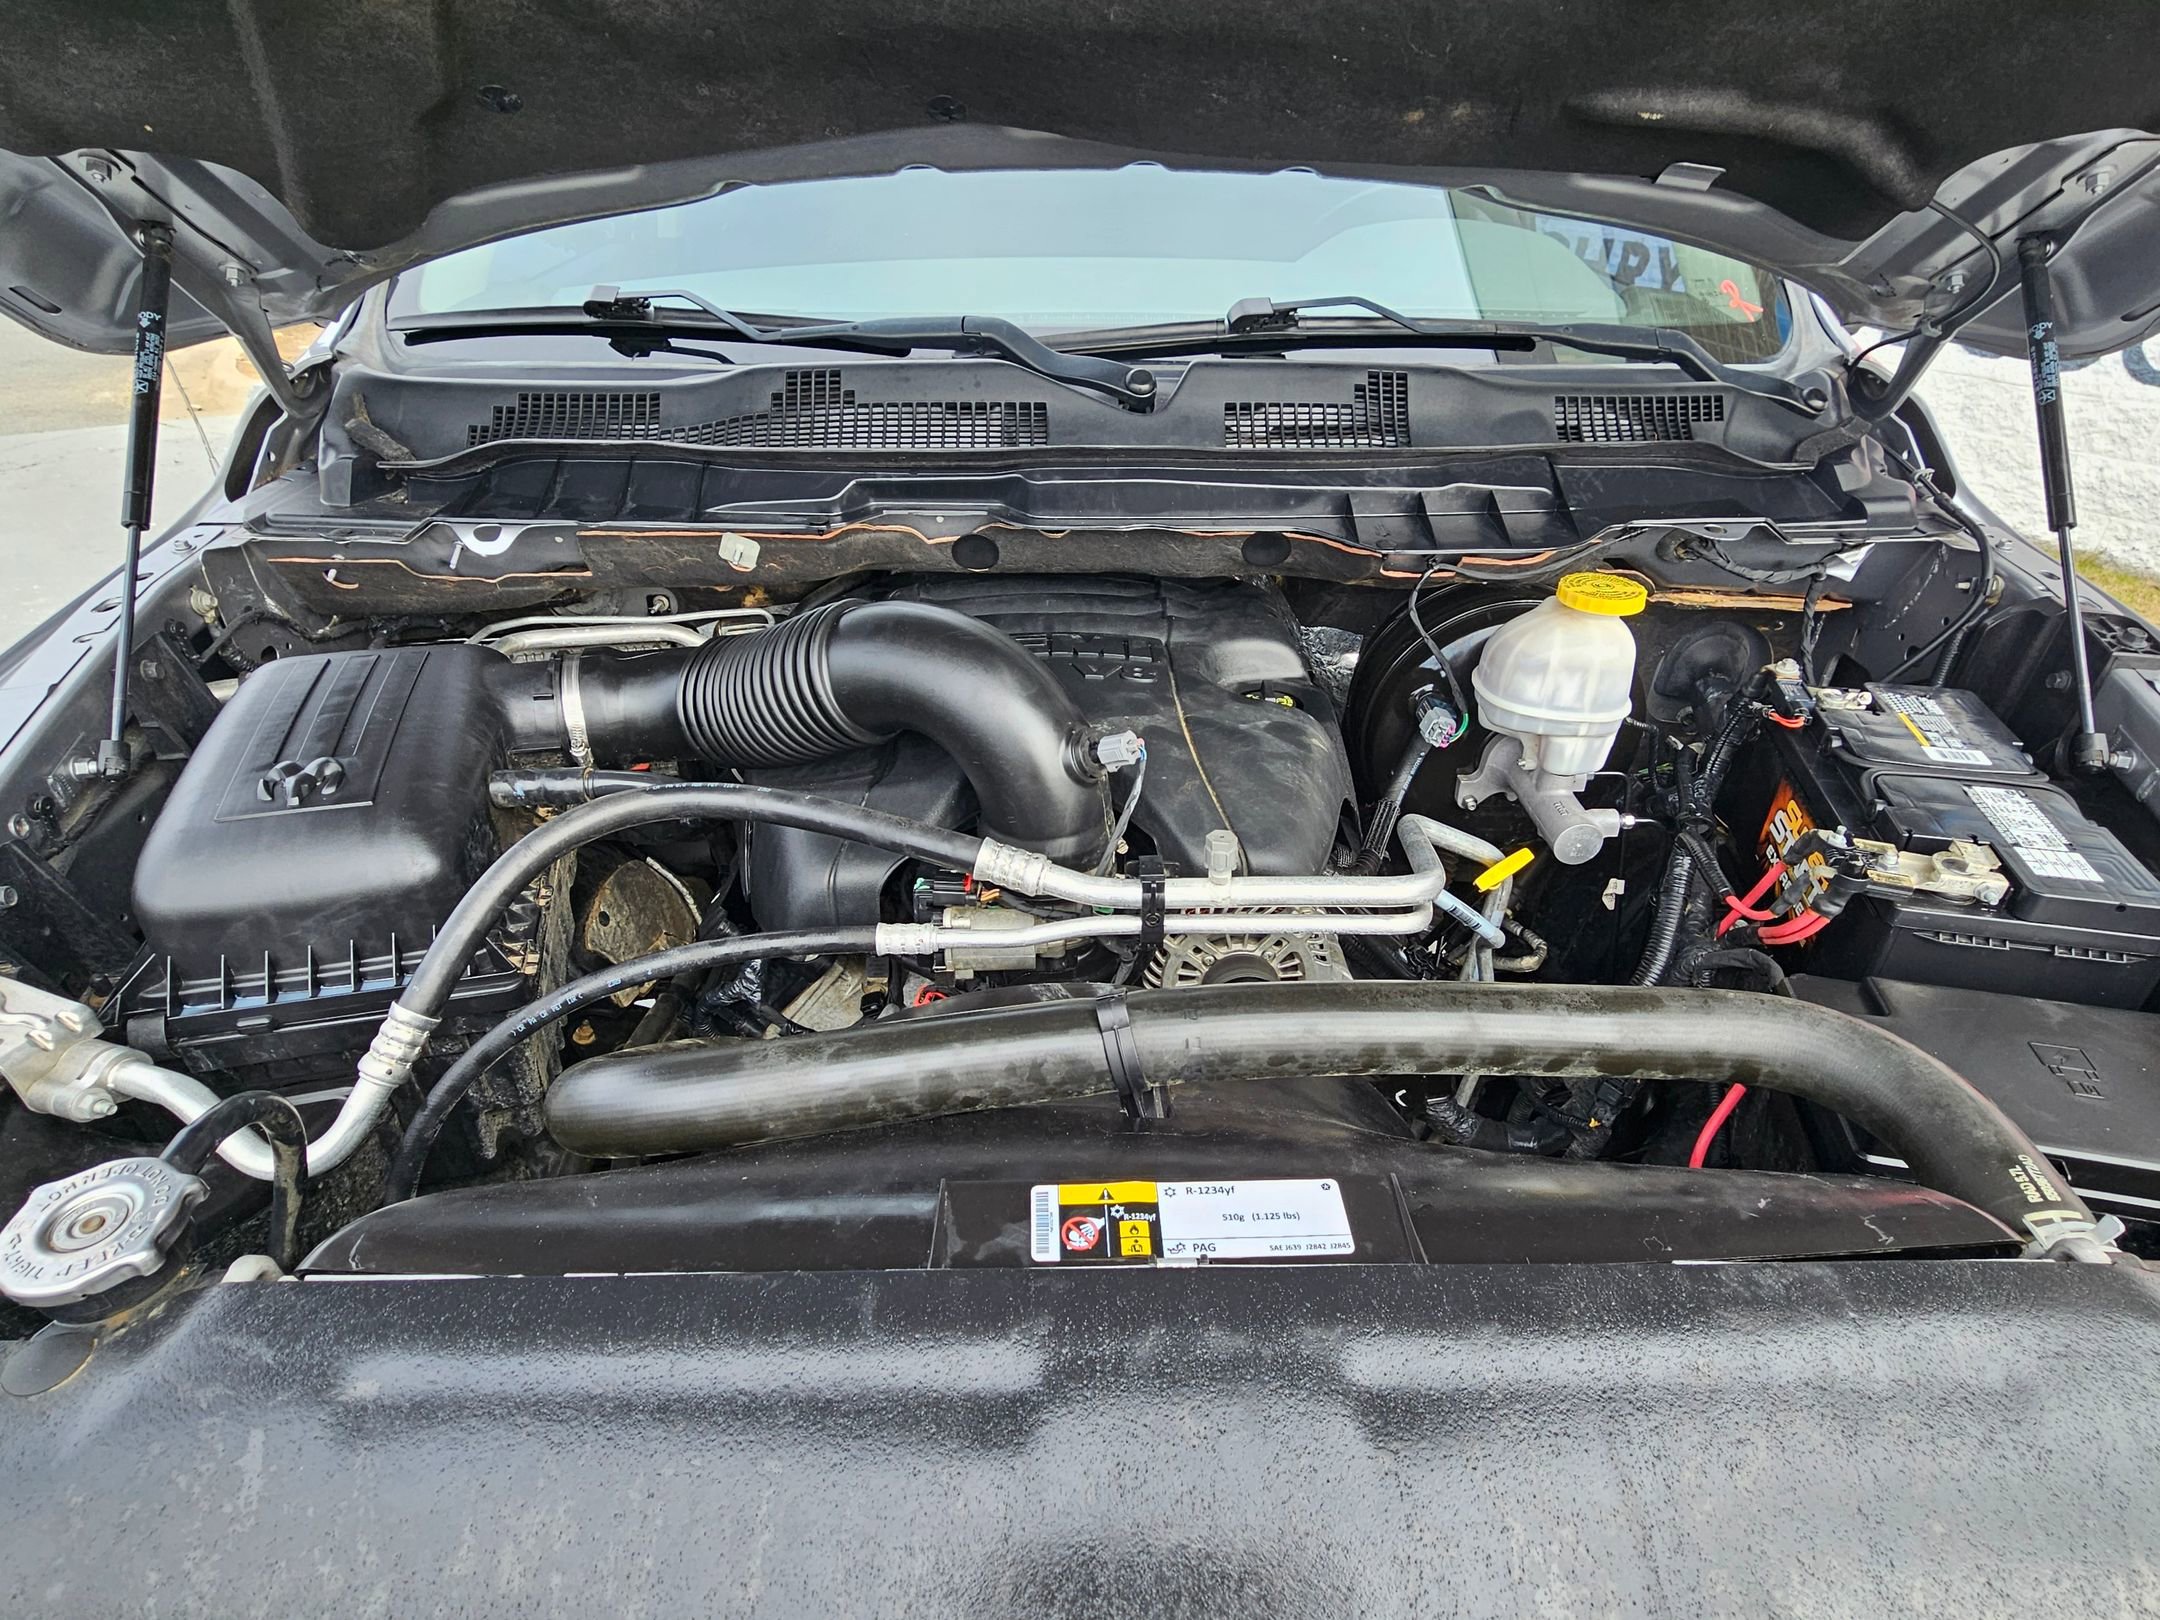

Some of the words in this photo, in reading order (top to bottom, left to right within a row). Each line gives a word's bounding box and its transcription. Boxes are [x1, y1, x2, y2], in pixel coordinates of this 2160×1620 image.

[138, 311, 161, 321] ODY
[2028, 321, 2053, 334] ODY
[1185, 1186, 1236, 1198] R-1234yf
[2019, 1182, 2044, 1203] RAD
[1123, 1212, 1156, 1223] R-1234yf
[1222, 1213, 1246, 1223] 510g
[1252, 1212, 1280, 1222] (1.125
[1282, 1211, 1301, 1222] lbs)
[1192, 1242, 1217, 1253] PAG
[1269, 1244, 1283, 1252] SAE
